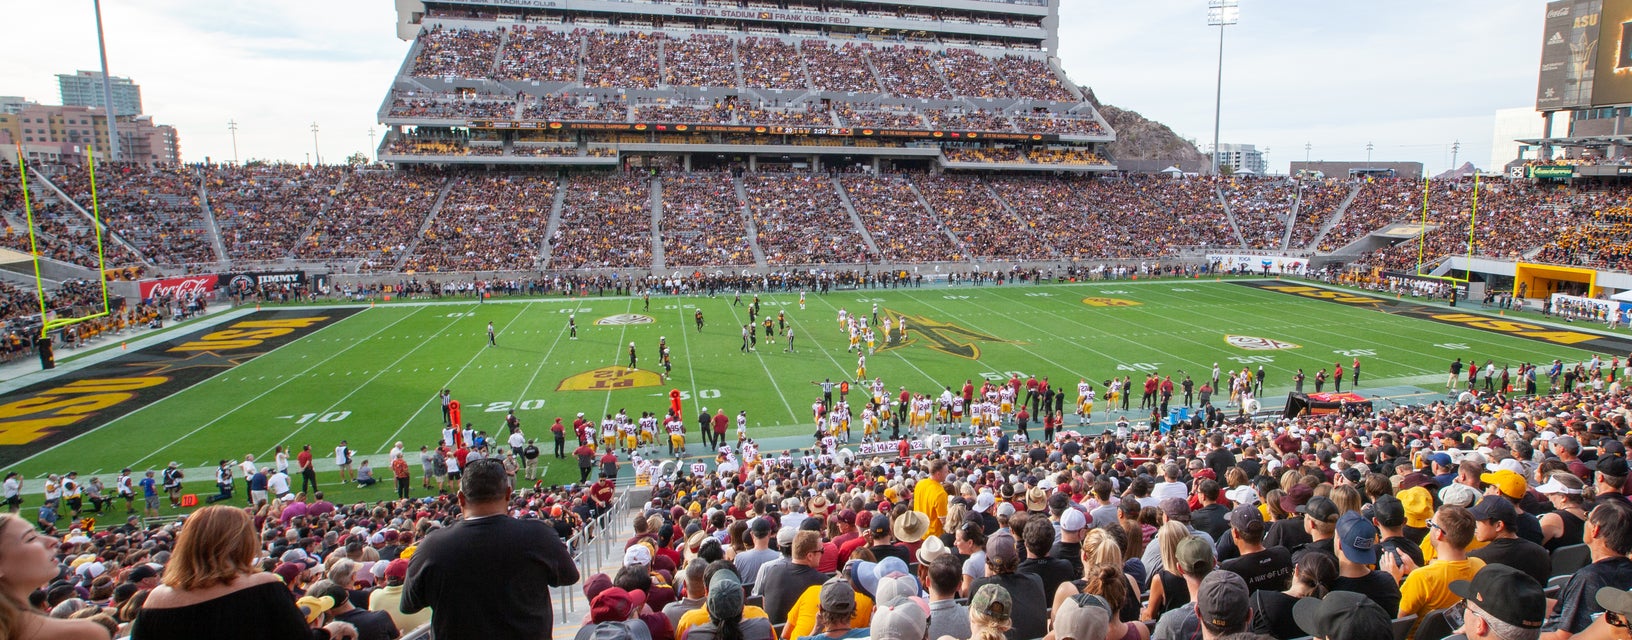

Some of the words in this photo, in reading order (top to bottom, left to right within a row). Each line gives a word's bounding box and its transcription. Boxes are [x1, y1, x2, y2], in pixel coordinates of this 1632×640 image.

[675, 7, 693, 15] SUN
[696, 8, 719, 16] DEVIL
[721, 10, 755, 18] STADIUM
[1573, 14, 1599, 28] ASU
[571, 27, 587, 36] 42
[258, 274, 298, 284] JIMMY
[841, 383, 847, 392] 2
[484, 399, 546, 413] 20
[295, 411, 352, 424] 10
[693, 465, 704, 473] 50
[183, 496, 193, 506] 10
[1277, 567, 1289, 576] LIFE
